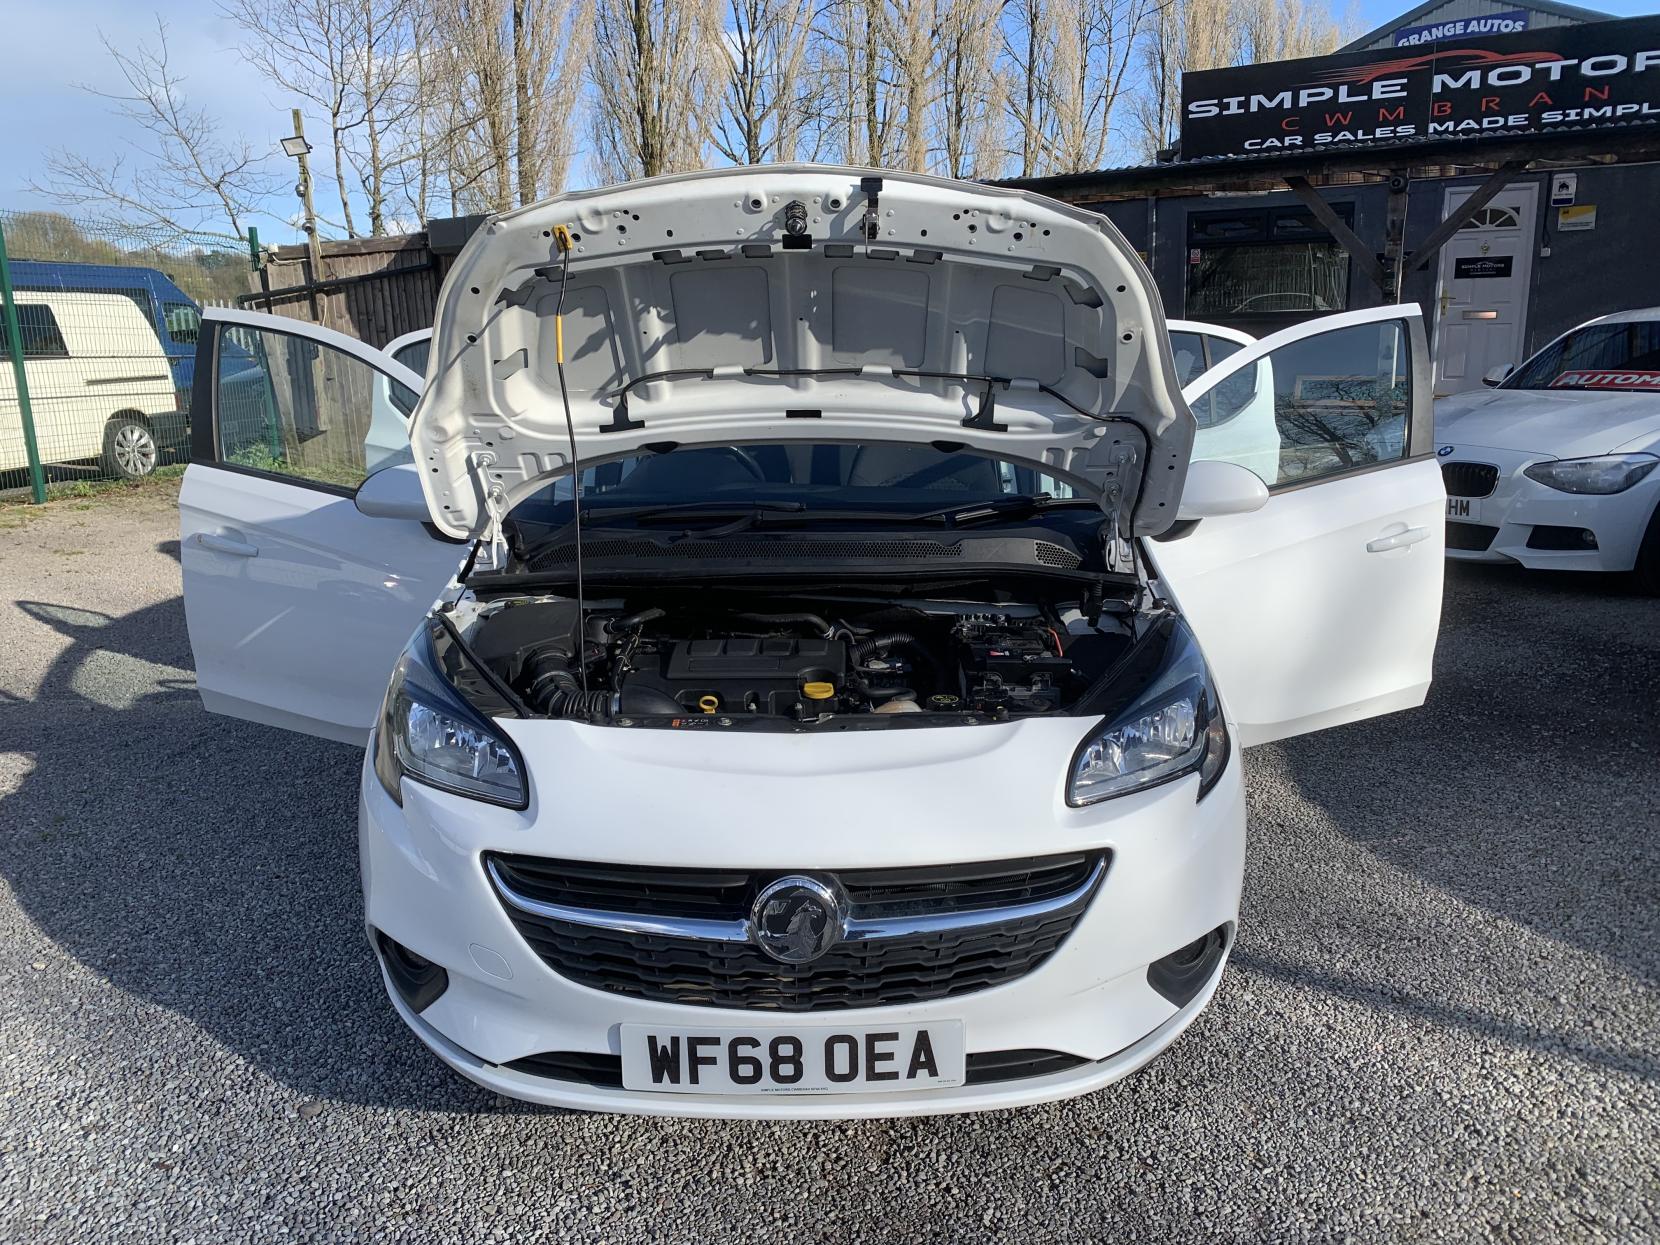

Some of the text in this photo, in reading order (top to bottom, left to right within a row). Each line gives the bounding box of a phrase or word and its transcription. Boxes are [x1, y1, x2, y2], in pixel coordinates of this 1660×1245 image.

[1397, 19, 1526, 47] GRANGE AUTOS
[1188, 78, 1408, 119] SIMPLE
[1243, 135, 1303, 150] CAR
[1313, 124, 1416, 144] SALES
[1428, 113, 1529, 134] MADE
[647, 1029, 939, 1085] WF68 OEA
